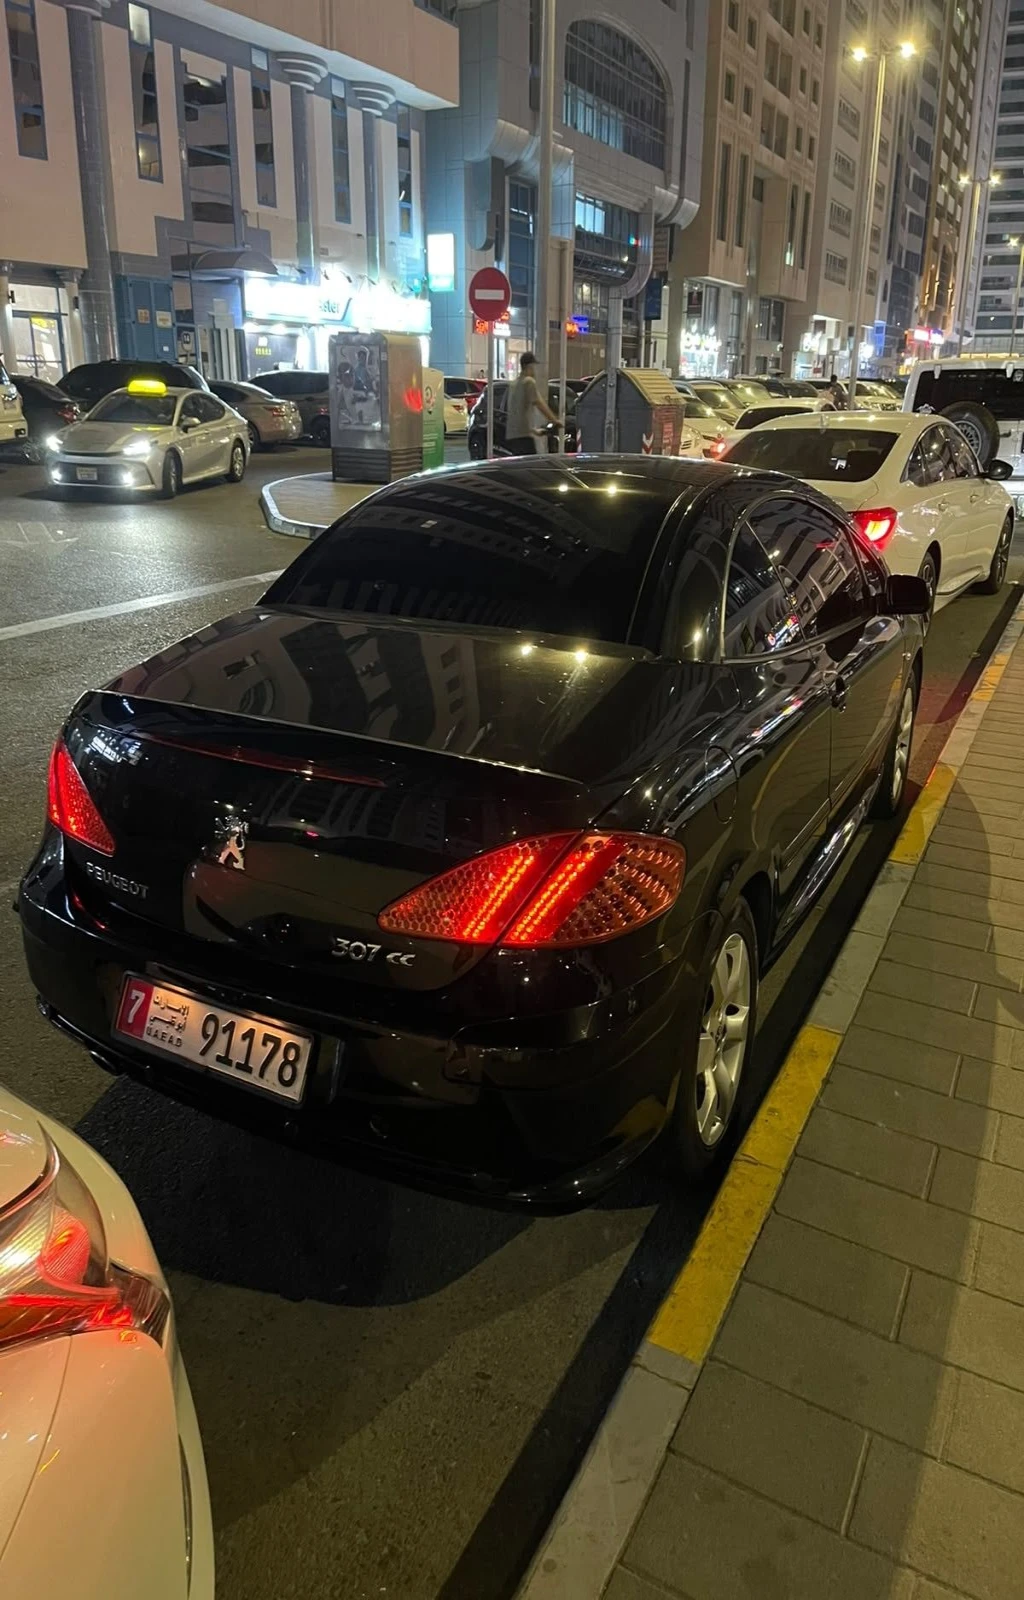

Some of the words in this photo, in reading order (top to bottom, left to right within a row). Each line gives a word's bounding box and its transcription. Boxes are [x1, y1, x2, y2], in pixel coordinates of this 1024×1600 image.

[85, 861, 149, 899] PEUGEOT
[331, 937, 382, 962] 307
[127, 988, 146, 1025] 7
[199, 1011, 302, 1088] 91178
